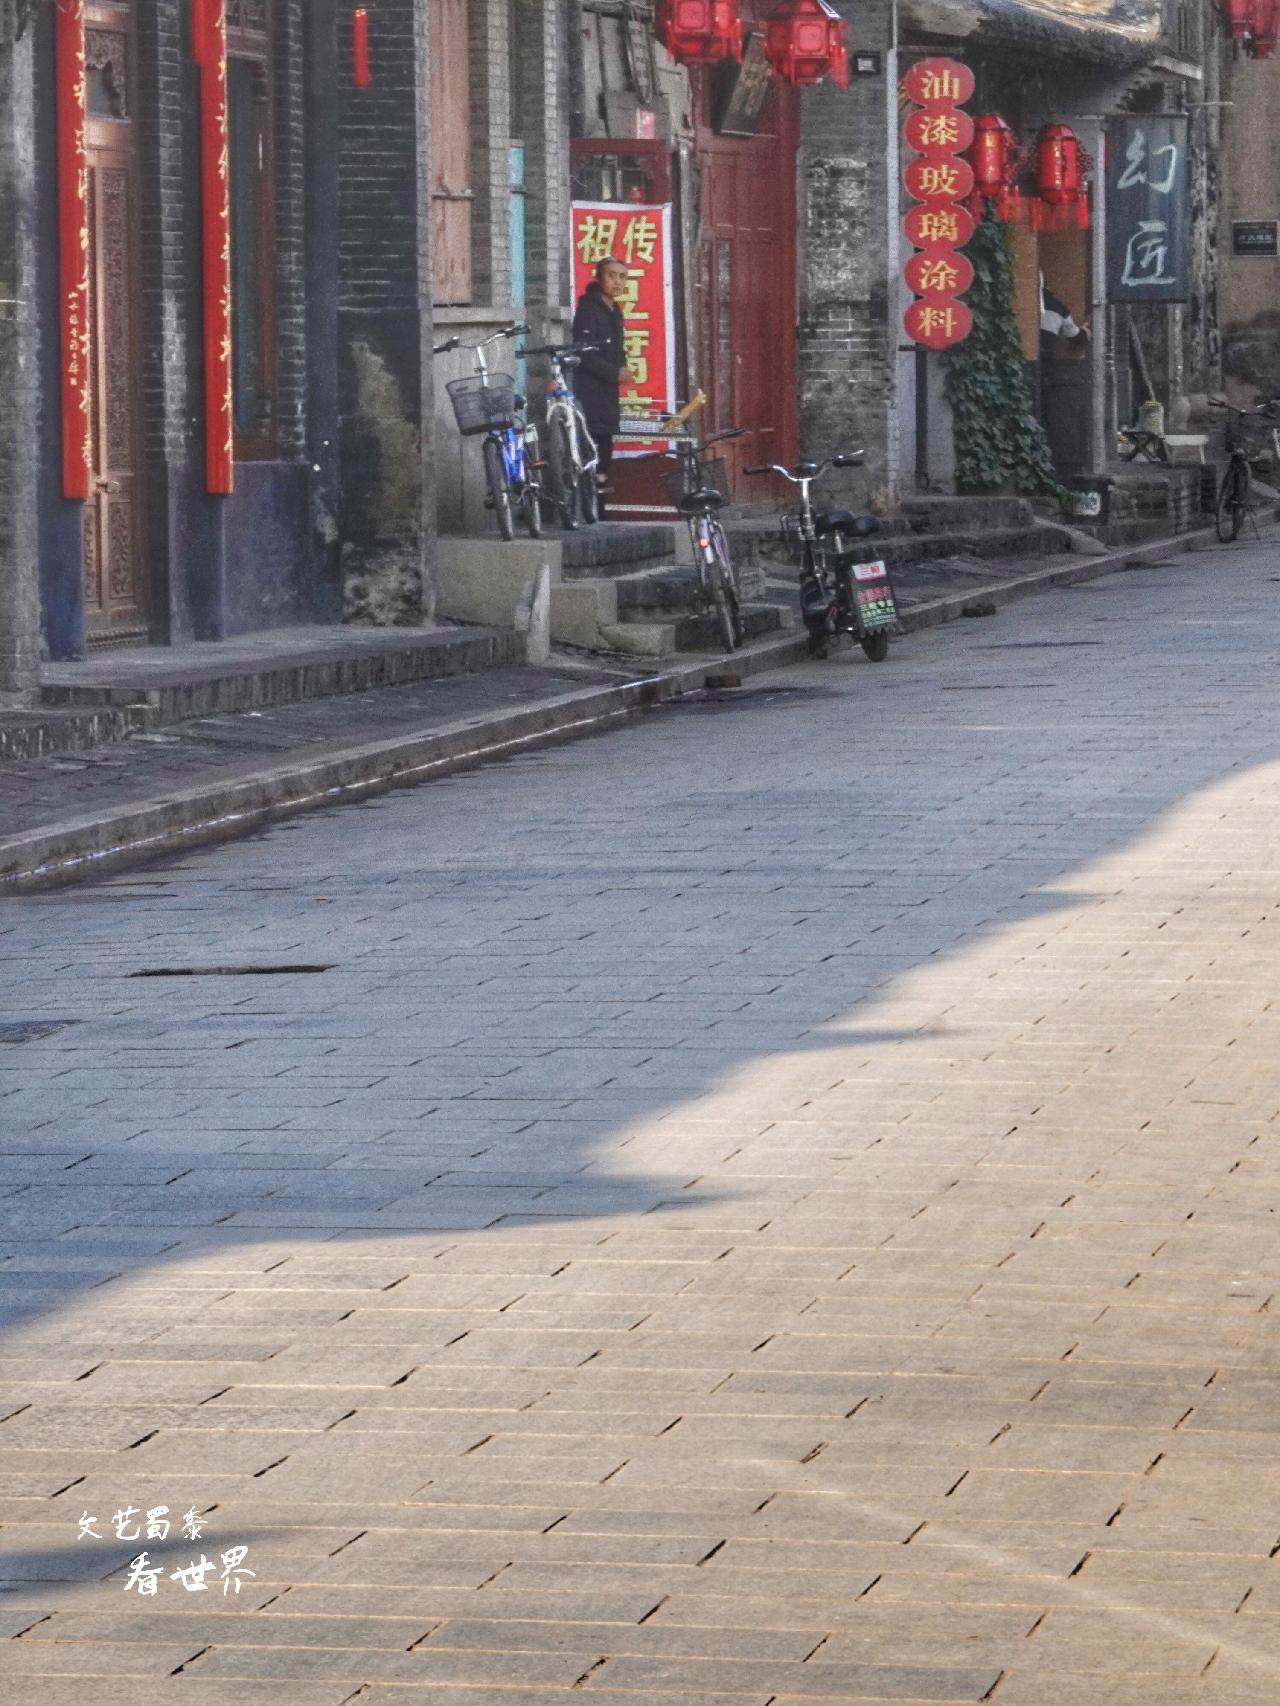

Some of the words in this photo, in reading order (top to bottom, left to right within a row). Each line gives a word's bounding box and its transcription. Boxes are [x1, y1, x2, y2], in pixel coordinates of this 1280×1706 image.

[576, 215, 658, 264] 祖传
[917, 71, 961, 338] 油漆玻璃涂料
